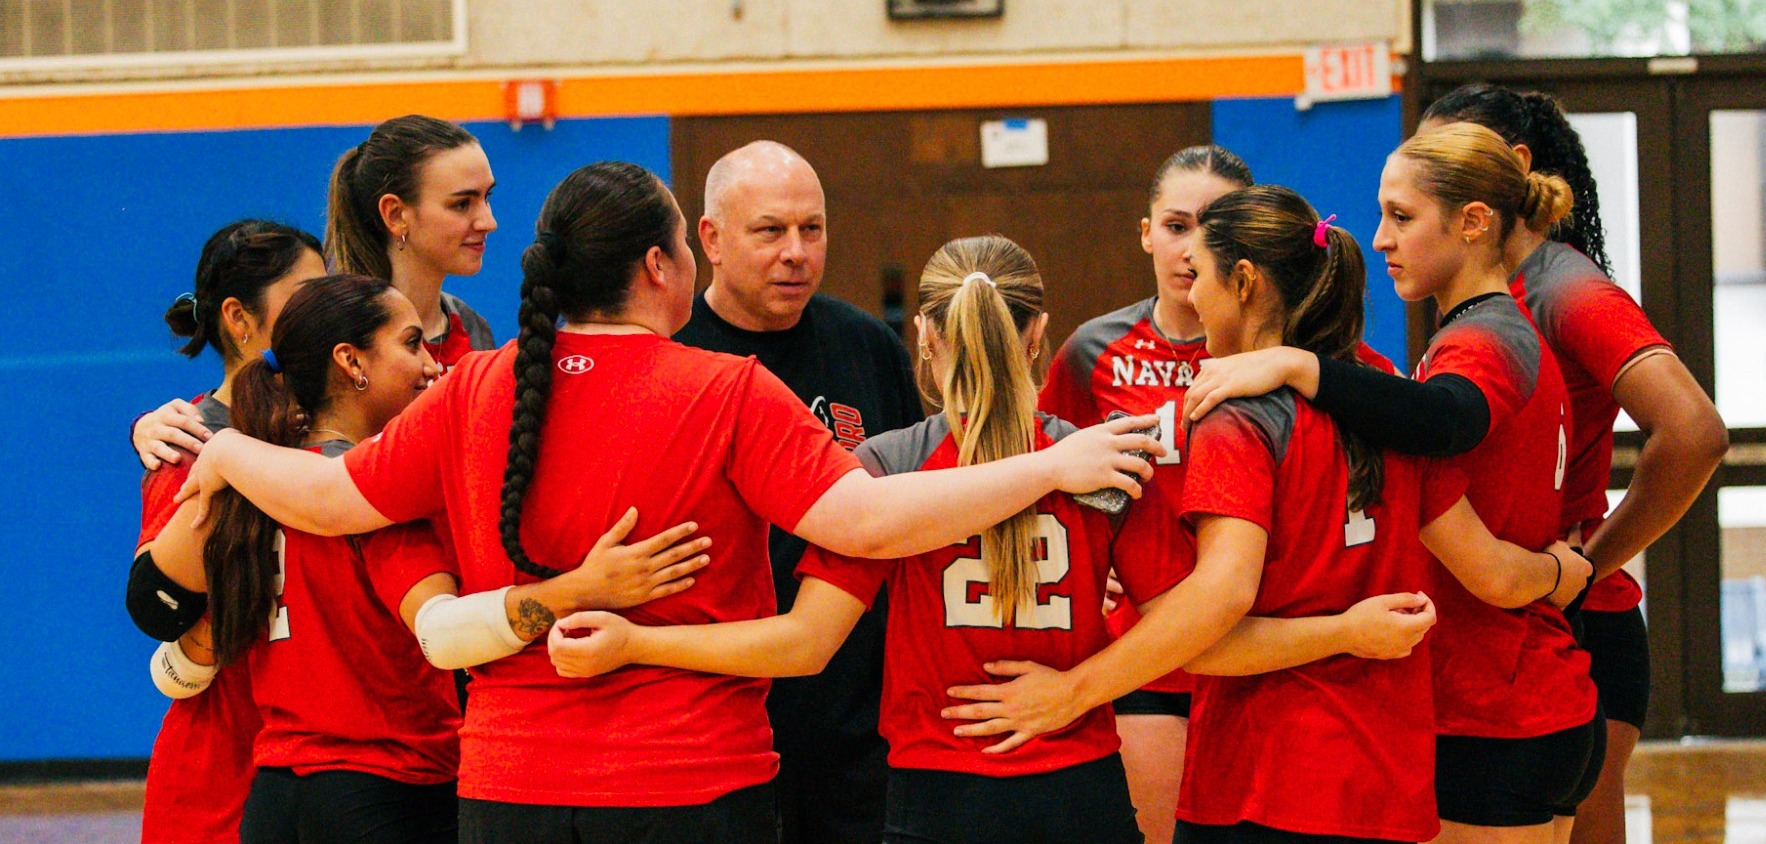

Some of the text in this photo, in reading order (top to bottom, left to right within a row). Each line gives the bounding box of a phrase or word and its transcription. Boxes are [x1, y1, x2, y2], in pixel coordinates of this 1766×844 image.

[1321, 44, 1375, 92] EXIT
[1112, 355, 1213, 387] NAVA
[943, 513, 1072, 630] 22
